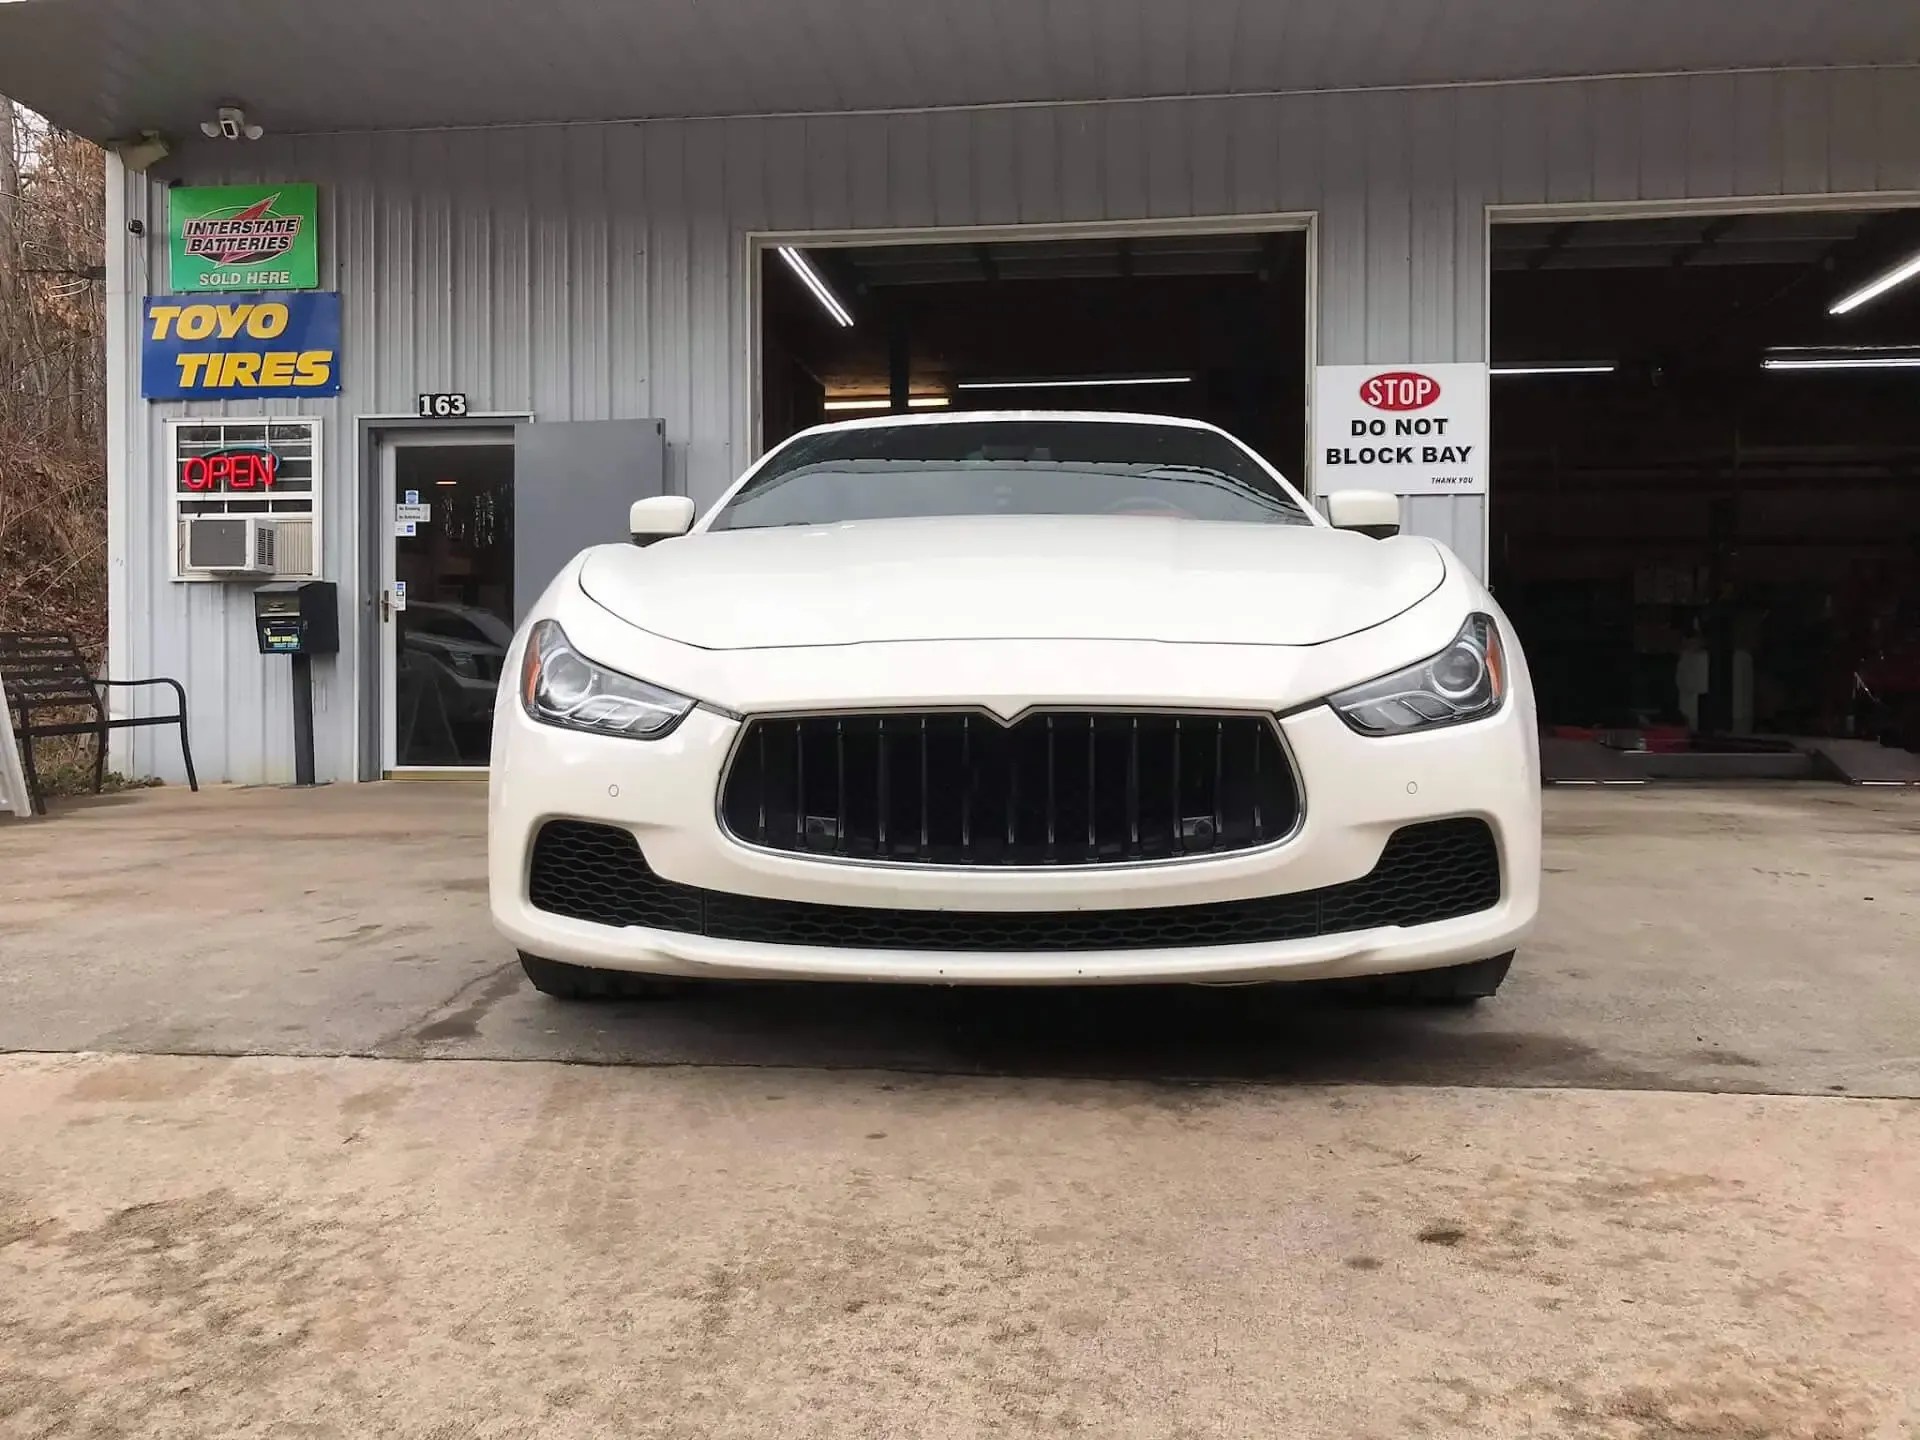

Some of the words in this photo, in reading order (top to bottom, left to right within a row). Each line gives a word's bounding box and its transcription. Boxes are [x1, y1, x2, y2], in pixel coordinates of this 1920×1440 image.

[187, 219, 298, 236] INTERSTATE
[190, 237, 291, 252] BATTERIES
[200, 273, 241, 286] SOLD
[247, 271, 290, 284] HERE
[149, 303, 289, 341] TOYO
[176, 351, 333, 388] TIRES
[1368, 379, 1432, 406] STOP
[420, 395, 466, 416] 163
[1351, 419, 1386, 436] DO
[1395, 418, 1448, 436] NOT
[1326, 447, 1413, 465] BLOCK
[1422, 446, 1472, 463] BAY
[184, 453, 277, 490] OPEN
